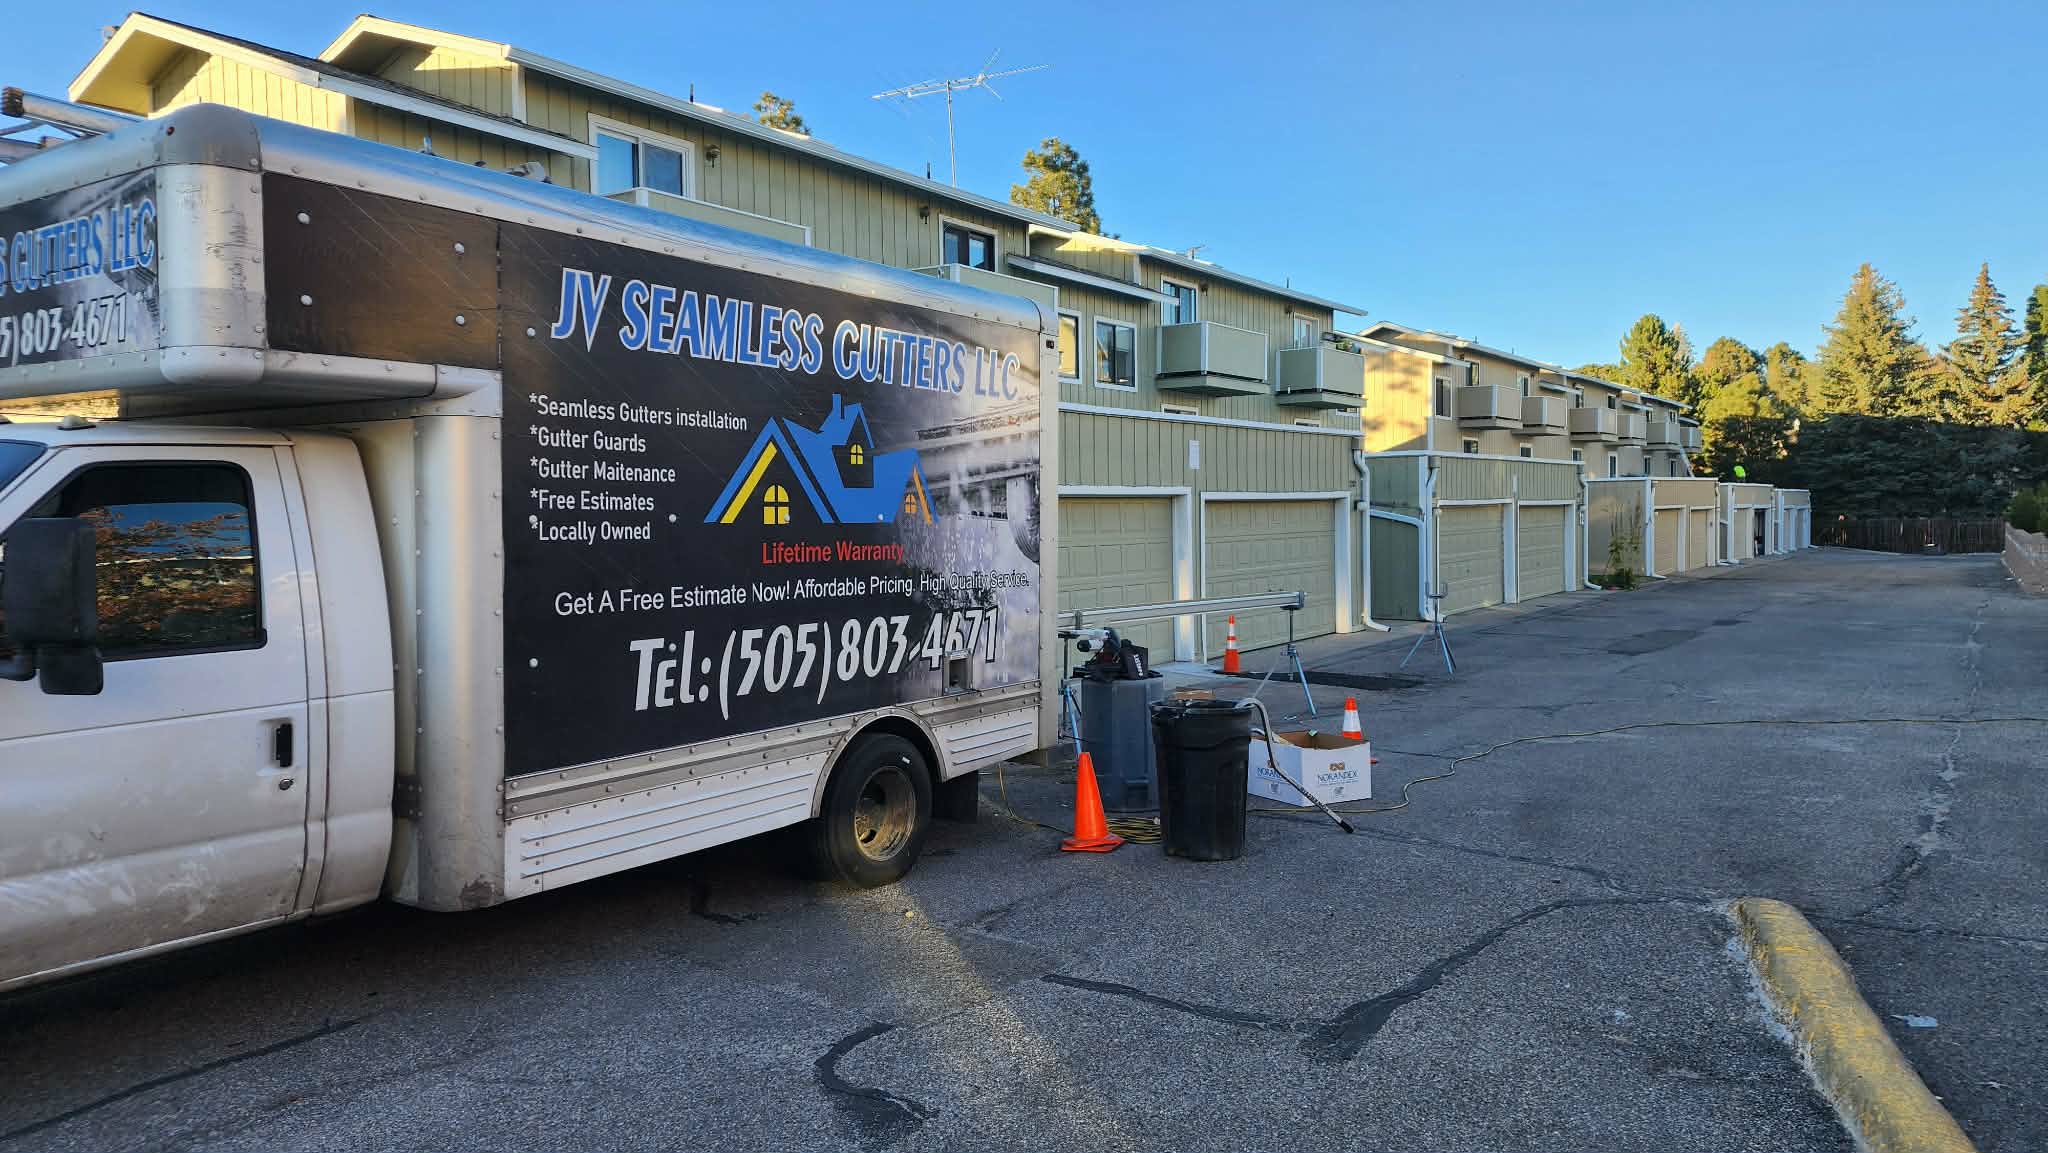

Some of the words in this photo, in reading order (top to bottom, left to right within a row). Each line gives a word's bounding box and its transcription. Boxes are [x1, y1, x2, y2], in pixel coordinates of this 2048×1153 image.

[10, 211, 104, 293] GUTTERS
[110, 198, 156, 272] LLC
[551, 267, 612, 352] JV
[619, 279, 824, 375] SEAMLESS
[833, 320, 967, 396] GUTTERS
[975, 347, 1021, 400] LLC
[619, 403, 672, 425] Gutters
[676, 407, 748, 431] installation
[593, 430, 646, 453] Guards
[594, 461, 676, 482] Maitenance
[580, 490, 655, 511] Estimates
[601, 521, 651, 541] Owned
[762, 541, 832, 565] Lifetime
[836, 540, 905, 565] Warranty
[555, 592, 594, 616] Get
[598, 590, 615, 613] A
[620, 589, 664, 611] Free
[670, 584, 747, 608] Estimate
[752, 579, 790, 603] Now!
[794, 576, 866, 599] Affordable
[870, 574, 915, 597] Pricing.
[920, 574, 946, 595] High
[950, 570, 988, 593] Quality
[989, 569, 1030, 588] Service.
